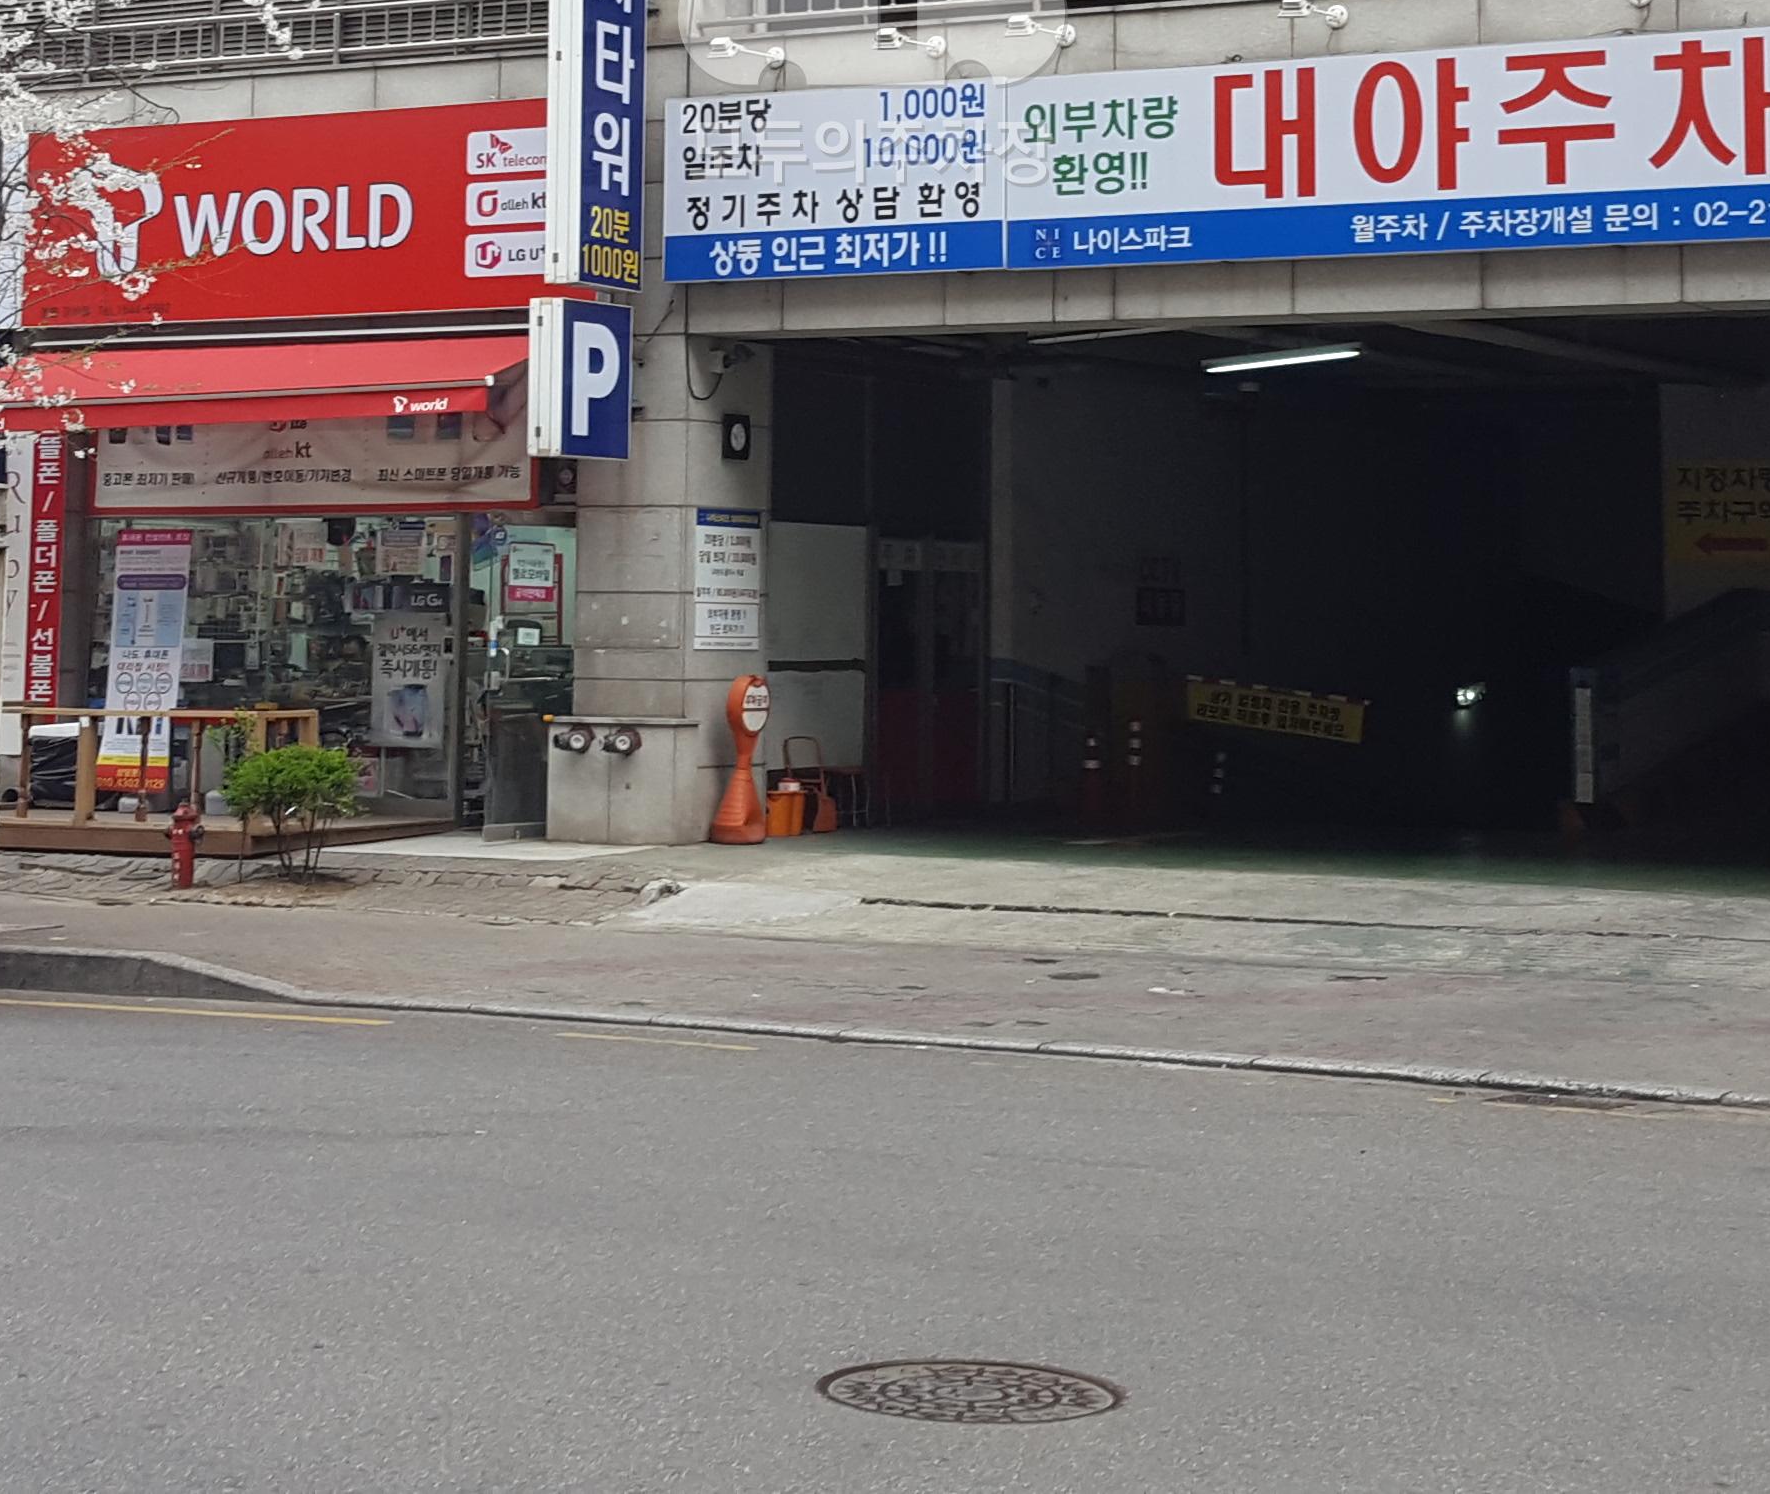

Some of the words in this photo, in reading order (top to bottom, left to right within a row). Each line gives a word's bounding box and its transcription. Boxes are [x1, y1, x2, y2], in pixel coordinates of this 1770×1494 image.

[681, 97, 773, 136] 20분당
[878, 83, 987, 125] 1,000원
[1023, 95, 1179, 145] 외부차량
[476, 152, 496, 168] SK
[682, 142, 764, 180] 일주차
[862, 128, 987, 170] 10,000원
[1052, 152, 1149, 196] 환영!!
[174, 182, 413, 258] WORLD
[590, 205, 631, 245] 20분
[686, 189, 820, 231] 정기주차
[835, 184, 915, 225] 상담
[917, 180, 981, 219] 환영
[1350, 213, 1428, 244] 월주차
[1458, 204, 1594, 239] 주차장개설
[1603, 203, 1659, 232] 문의
[508, 249, 525, 261] LG
[709, 236, 766, 276] 상동
[770, 236, 827, 271] 인근
[835, 233, 921, 269] 최저가
[1072, 224, 1193, 256] 나이스파크
[581, 243, 640, 286] 1000원
[571, 321, 620, 437] P
[296, 441, 311, 458] kt
